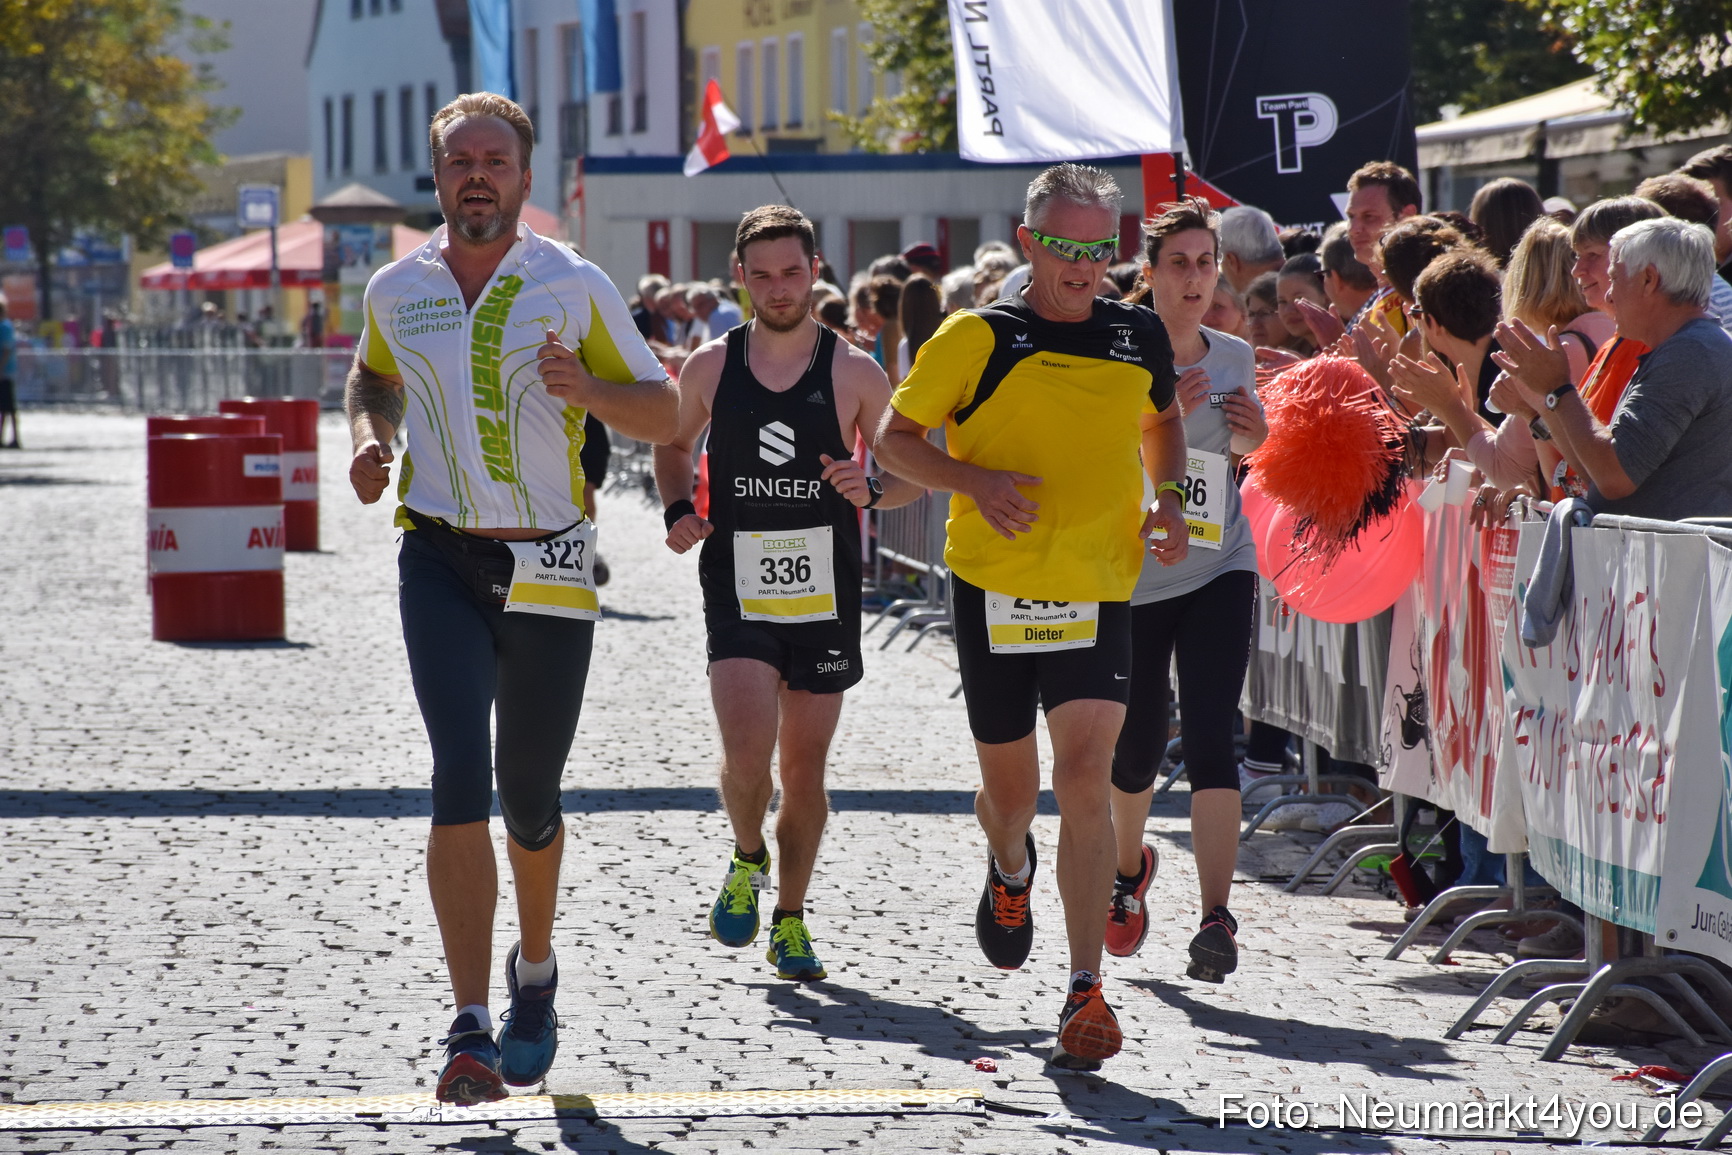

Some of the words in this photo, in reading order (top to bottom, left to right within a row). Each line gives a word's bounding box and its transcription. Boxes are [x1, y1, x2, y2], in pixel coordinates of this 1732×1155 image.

[1263, 102, 1287, 111] Team
[397, 296, 460, 315] cadion
[398, 309, 462, 328] Rothsee
[397, 320, 462, 340] Triathlon
[470, 273, 525, 412] FINISHER
[1041, 360, 1070, 369] Dieter
[475, 414, 520, 485] 2012
[734, 476, 821, 500] SINGER
[762, 537, 807, 549] BOCK
[535, 539, 586, 572] 323
[535, 573, 557, 581] PARTL
[760, 555, 811, 585] 336
[1010, 613, 1033, 621] PARTL
[1034, 612, 1067, 621] Neumarkt
[1025, 627, 1065, 641] Dieter
[1690, 903, 1717, 935] Jura
